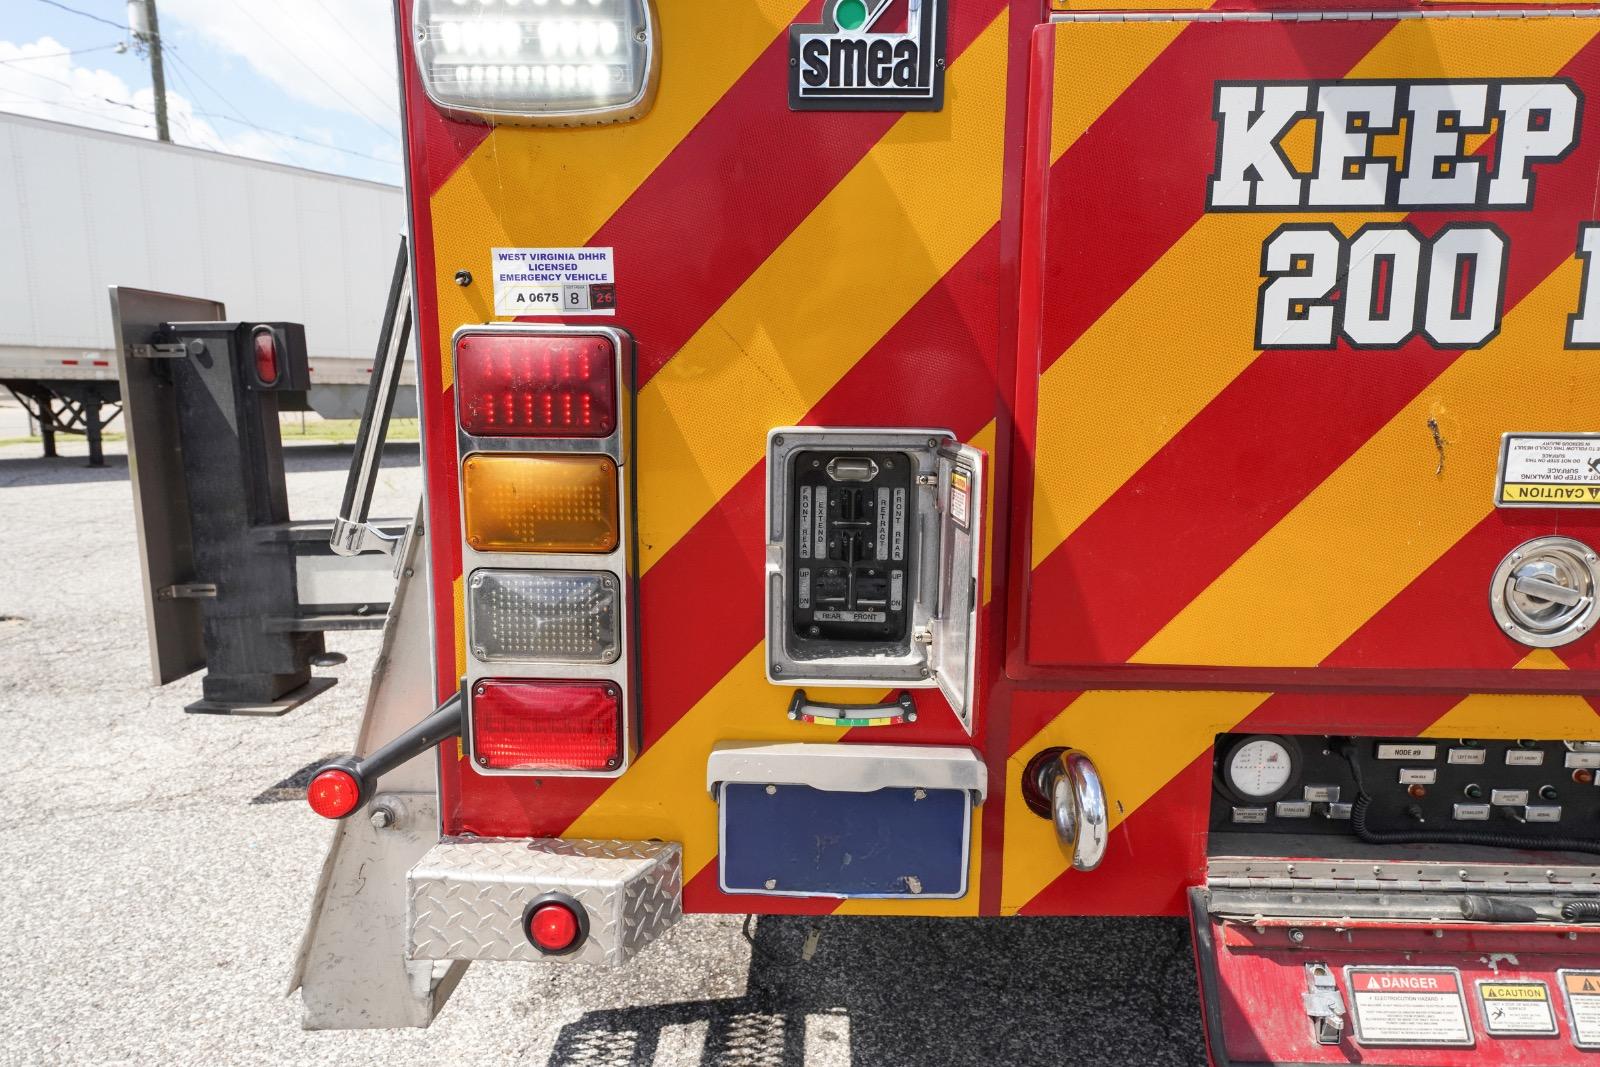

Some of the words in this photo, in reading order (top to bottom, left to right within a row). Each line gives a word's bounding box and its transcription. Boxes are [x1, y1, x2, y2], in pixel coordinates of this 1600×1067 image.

[1207, 78, 1584, 212] KEEP
[565, 273, 608, 281] VEHICLE
[1256, 223, 1508, 349] 200
[516, 293, 526, 302] A
[529, 293, 559, 302] 0675
[570, 292, 579, 305] 8
[596, 293, 612, 303] 26
[1519, 487, 1584, 498] CAUTION
[1382, 978, 1438, 989] DANGER
[1498, 988, 1541, 997] CAUTION
